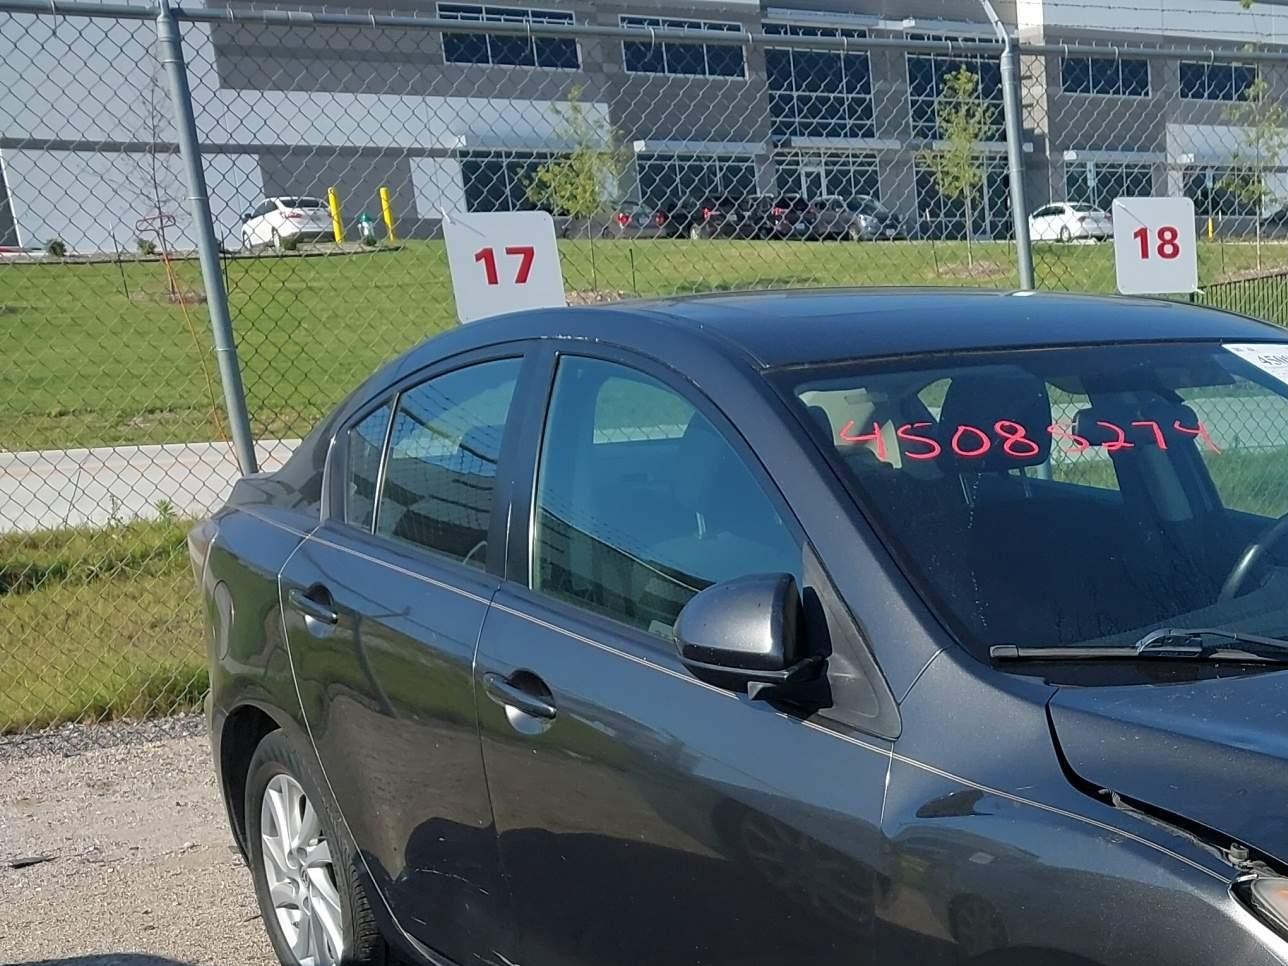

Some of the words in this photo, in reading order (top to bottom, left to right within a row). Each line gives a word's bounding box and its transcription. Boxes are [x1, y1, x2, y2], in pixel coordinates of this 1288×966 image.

[1133, 226, 1180, 259] 18
[475, 246, 535, 285] 17
[839, 420, 1222, 461] 45085274
